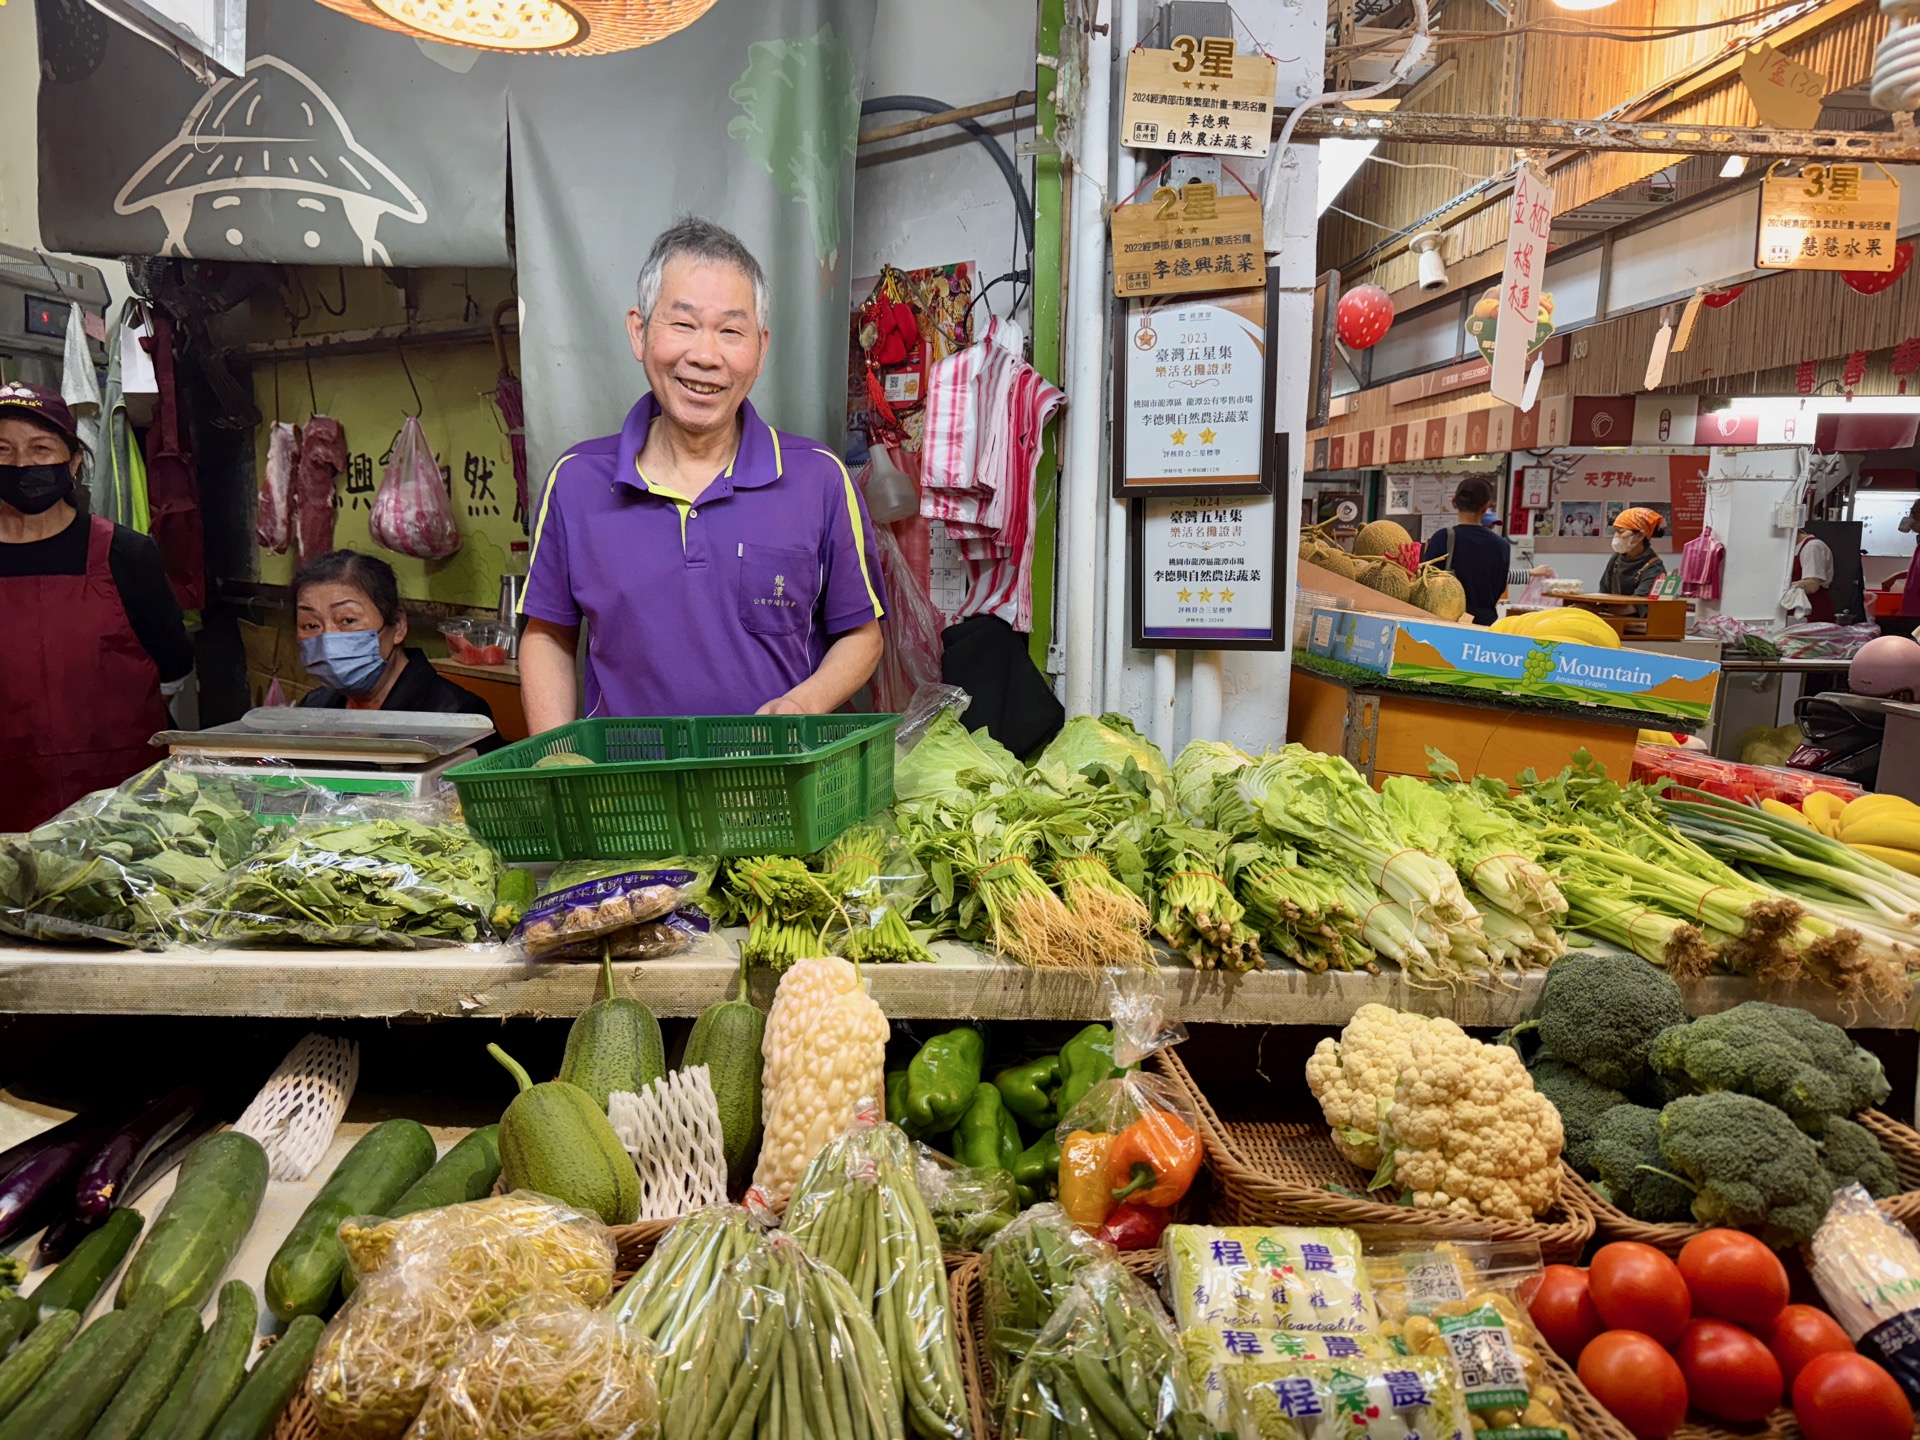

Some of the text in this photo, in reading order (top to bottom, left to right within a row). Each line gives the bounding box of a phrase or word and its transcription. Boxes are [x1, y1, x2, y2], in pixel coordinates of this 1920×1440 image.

[1172, 36, 1234, 79] 3星
[1187, 112, 1231, 130] 李德興
[1166, 129, 1253, 150] 自然農法蔬菜
[1803, 165, 1861, 201] 3星
[1153, 186, 1218, 221] 2星
[1152, 253, 1256, 280] 李德興蔬菜
[1180, 332, 1208, 344] 2023
[1155, 345, 1233, 363] 臺灣五星集
[1155, 362, 1233, 378] 樂活名攤證書
[1141, 410, 1249, 426] 李德興自然農法蔬菜
[1192, 497, 1220, 507] 2024
[1170, 508, 1243, 524] 臺灣五星集
[1170, 525, 1243, 538] 樂活名攤證書
[1153, 569, 1261, 582] 李德興自然農法蔬菜
[1461, 642, 1653, 686] Flavor Mountain
[1555, 675, 1607, 690] Amazing Grapes
[1204, 1309, 1262, 1326] Fresh
